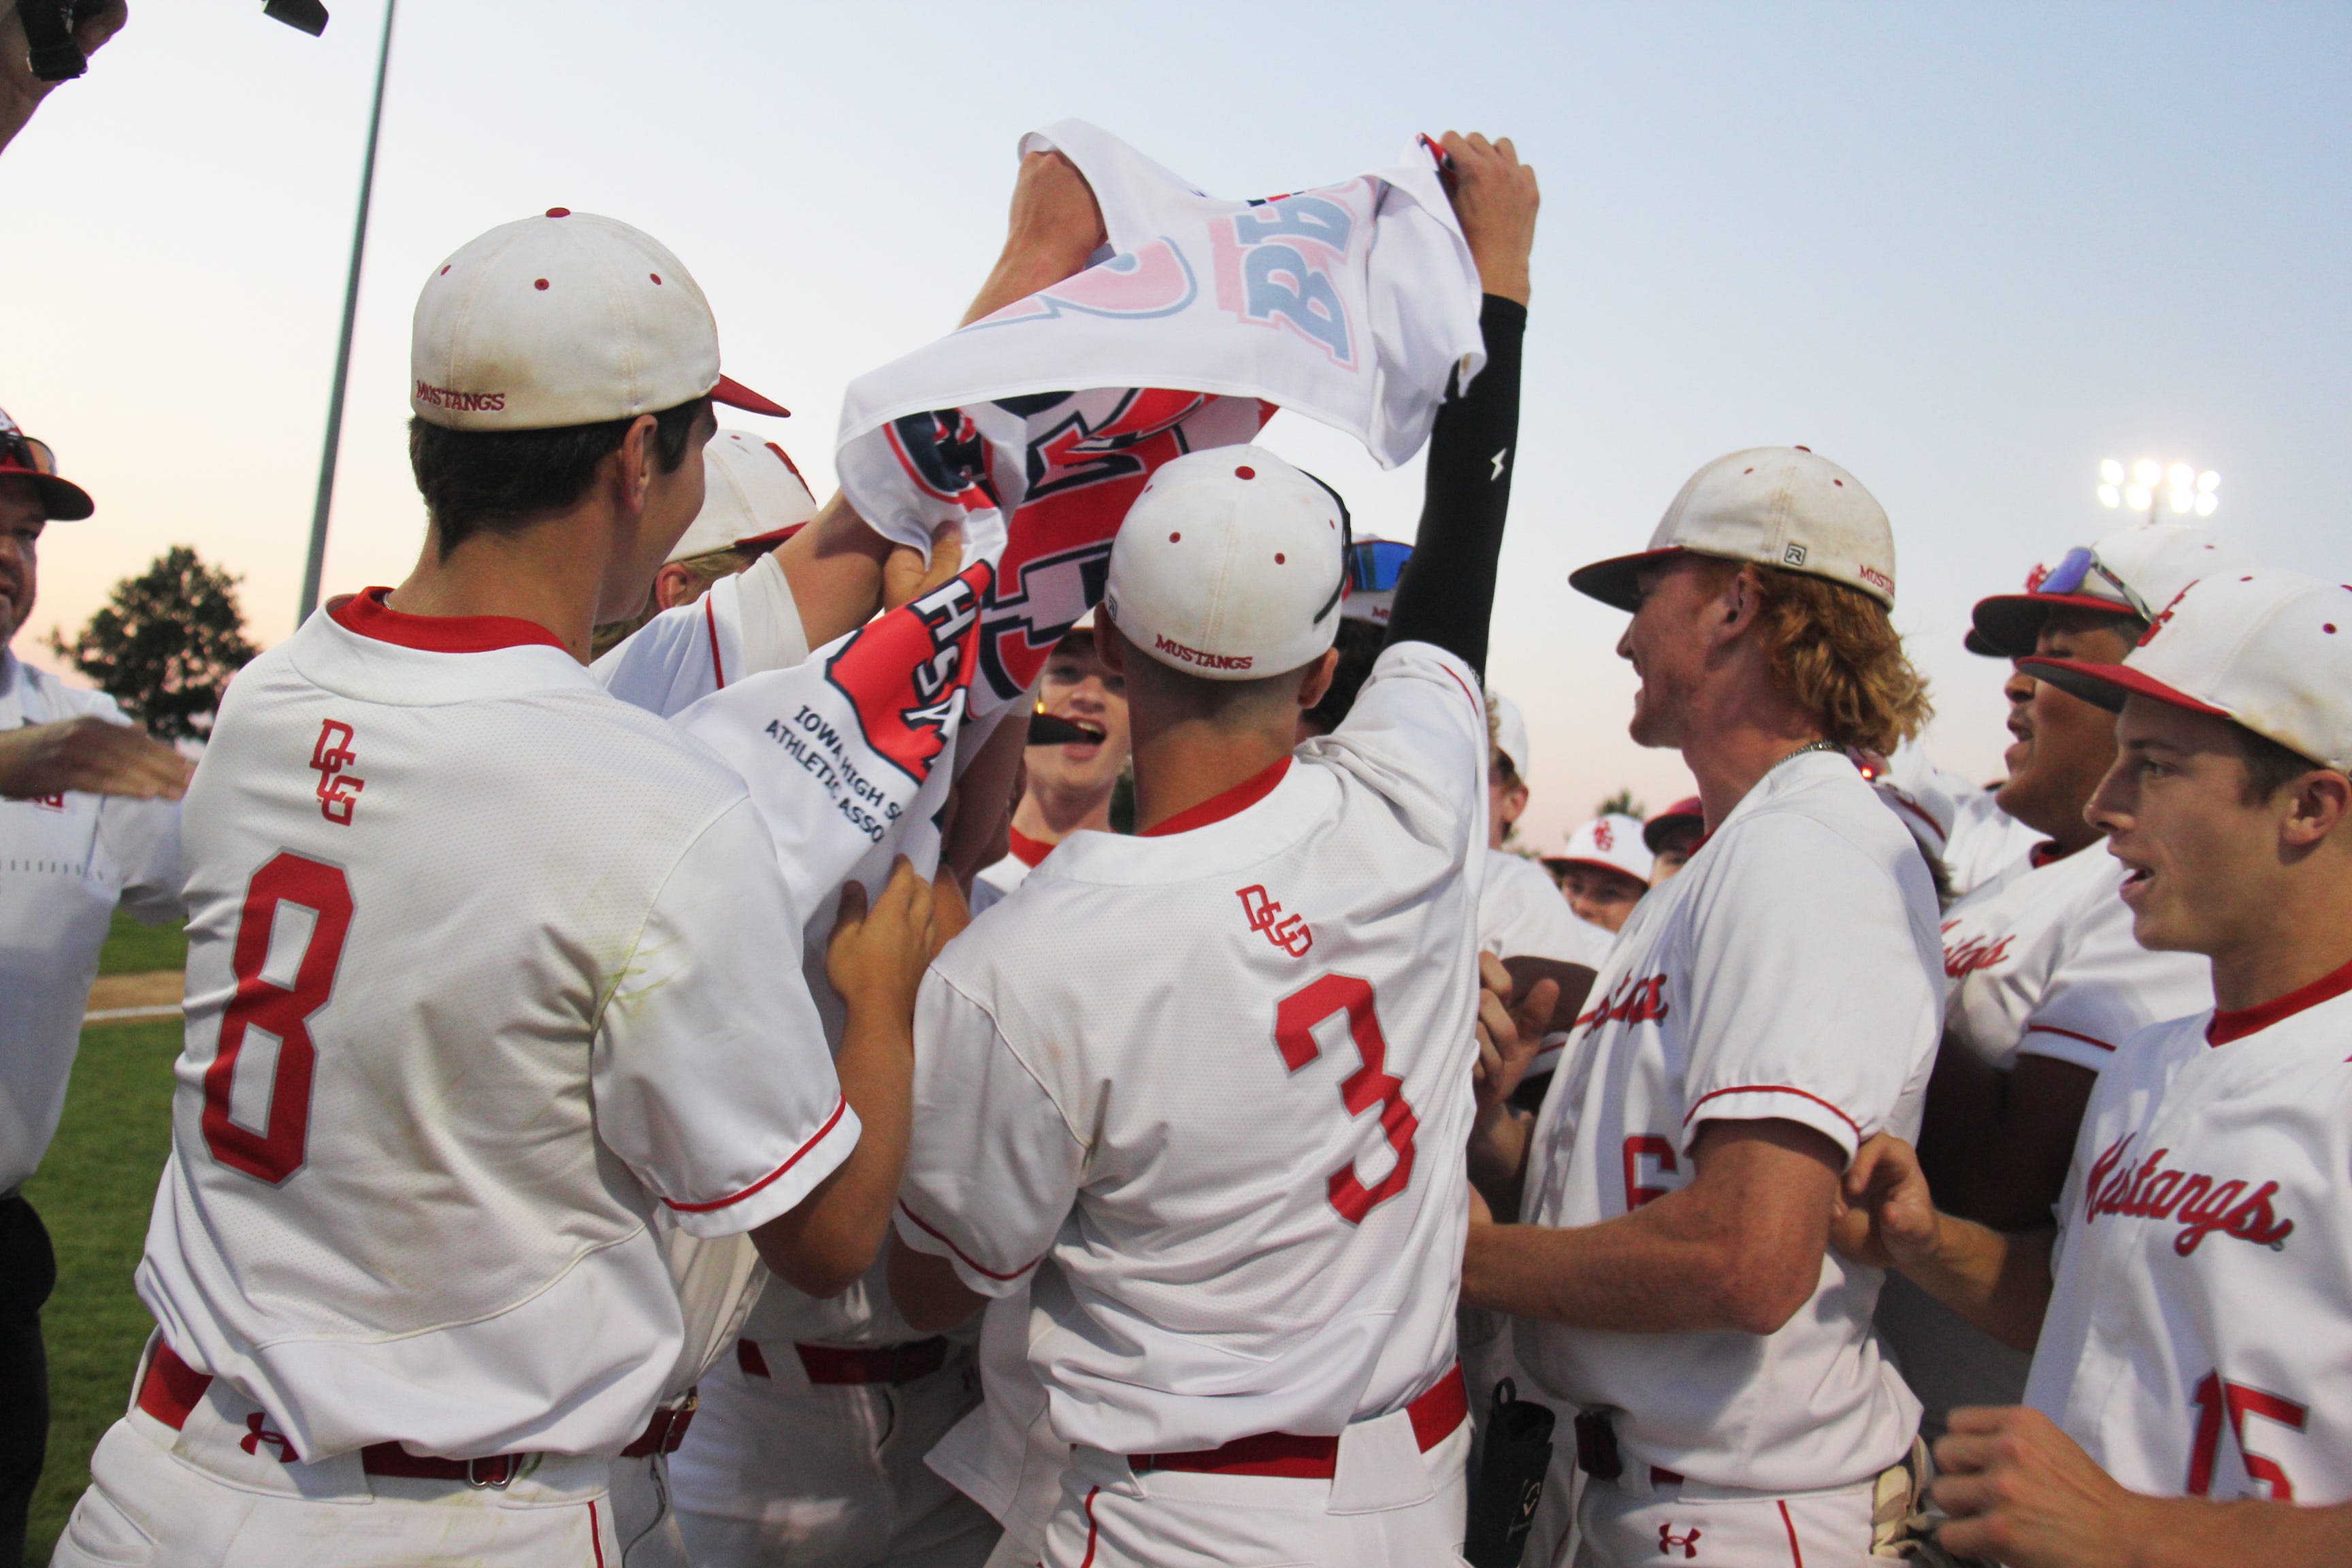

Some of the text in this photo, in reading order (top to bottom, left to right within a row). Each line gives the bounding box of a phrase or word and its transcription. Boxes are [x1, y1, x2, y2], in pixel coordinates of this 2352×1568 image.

[416, 379, 505, 412] MUSTANGS
[901, 576, 979, 769] HSA
[1155, 633, 1253, 670] MUSTANGS
[310, 718, 365, 827] DCG
[794, 704, 903, 822] IOWA HIGH S
[1235, 884, 1313, 958] DCG
[199, 845, 359, 1190] 8
[1270, 968, 1420, 1229] 3
[2086, 1132, 2294, 1257] Mustangs
[2185, 1367, 2309, 1503] 15
